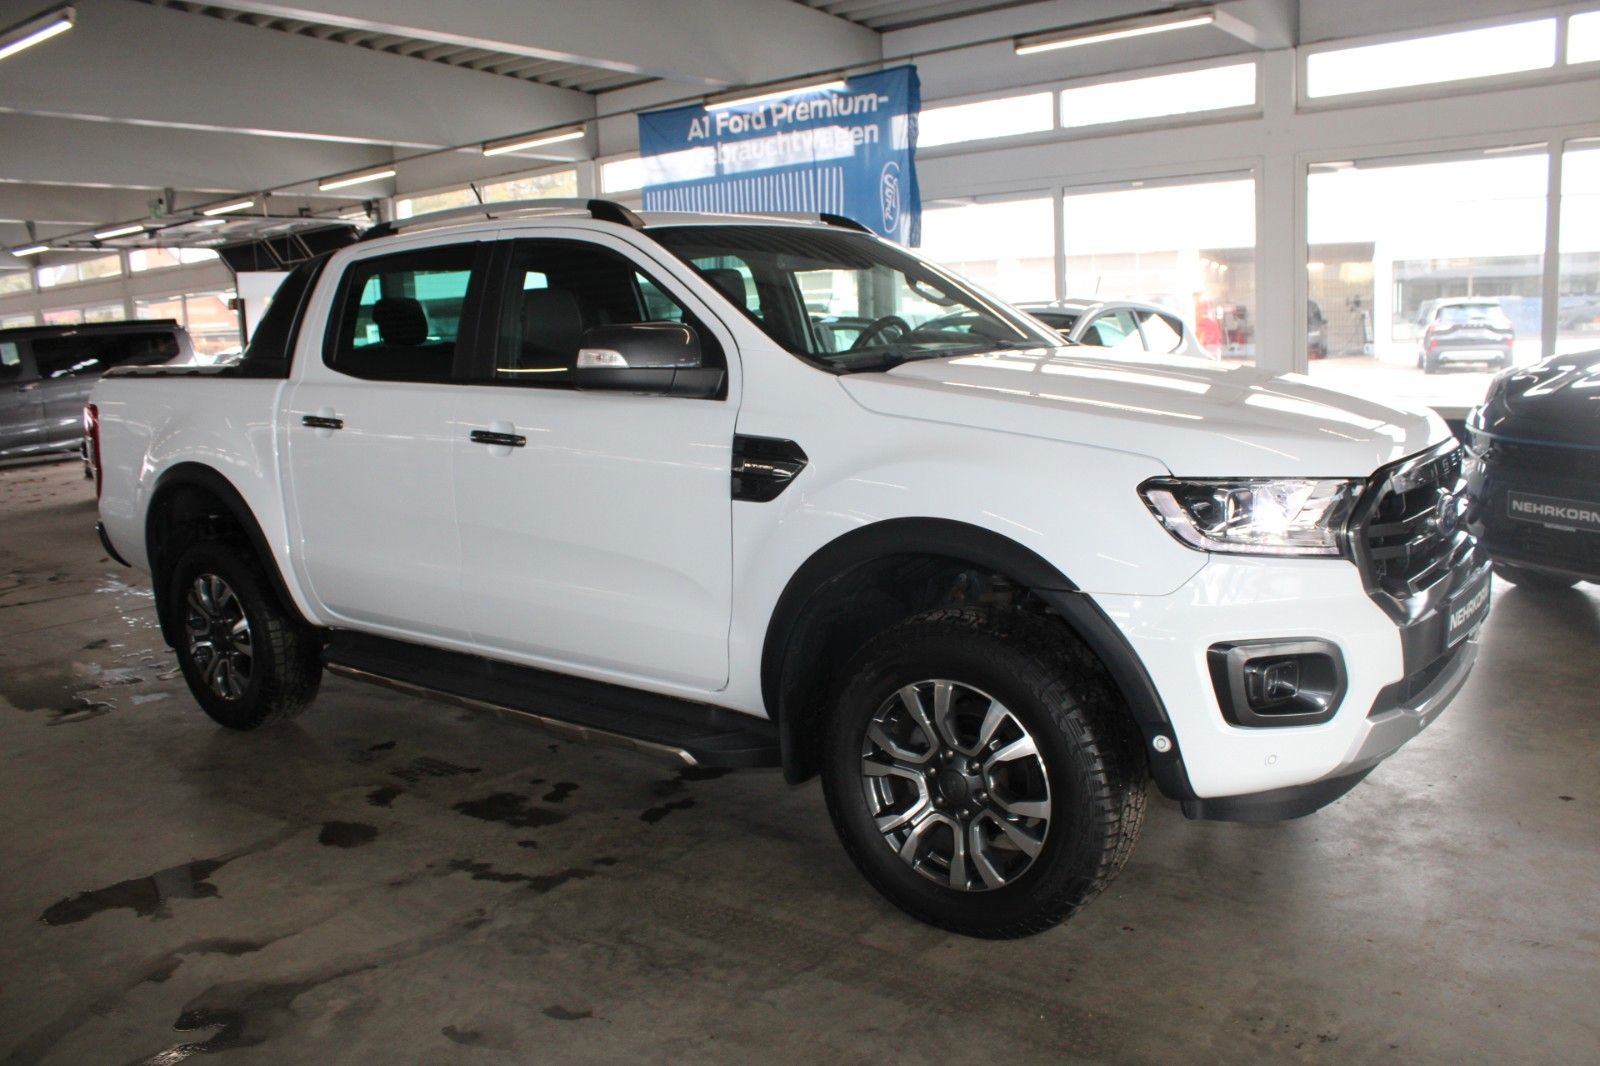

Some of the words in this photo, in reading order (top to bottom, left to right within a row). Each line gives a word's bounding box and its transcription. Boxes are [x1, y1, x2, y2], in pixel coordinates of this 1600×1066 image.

[716, 106, 766, 135] Ford
[771, 92, 889, 127] Premium-
[883, 173, 898, 221] Ford
[1512, 500, 1600, 523] NEHRKORN
